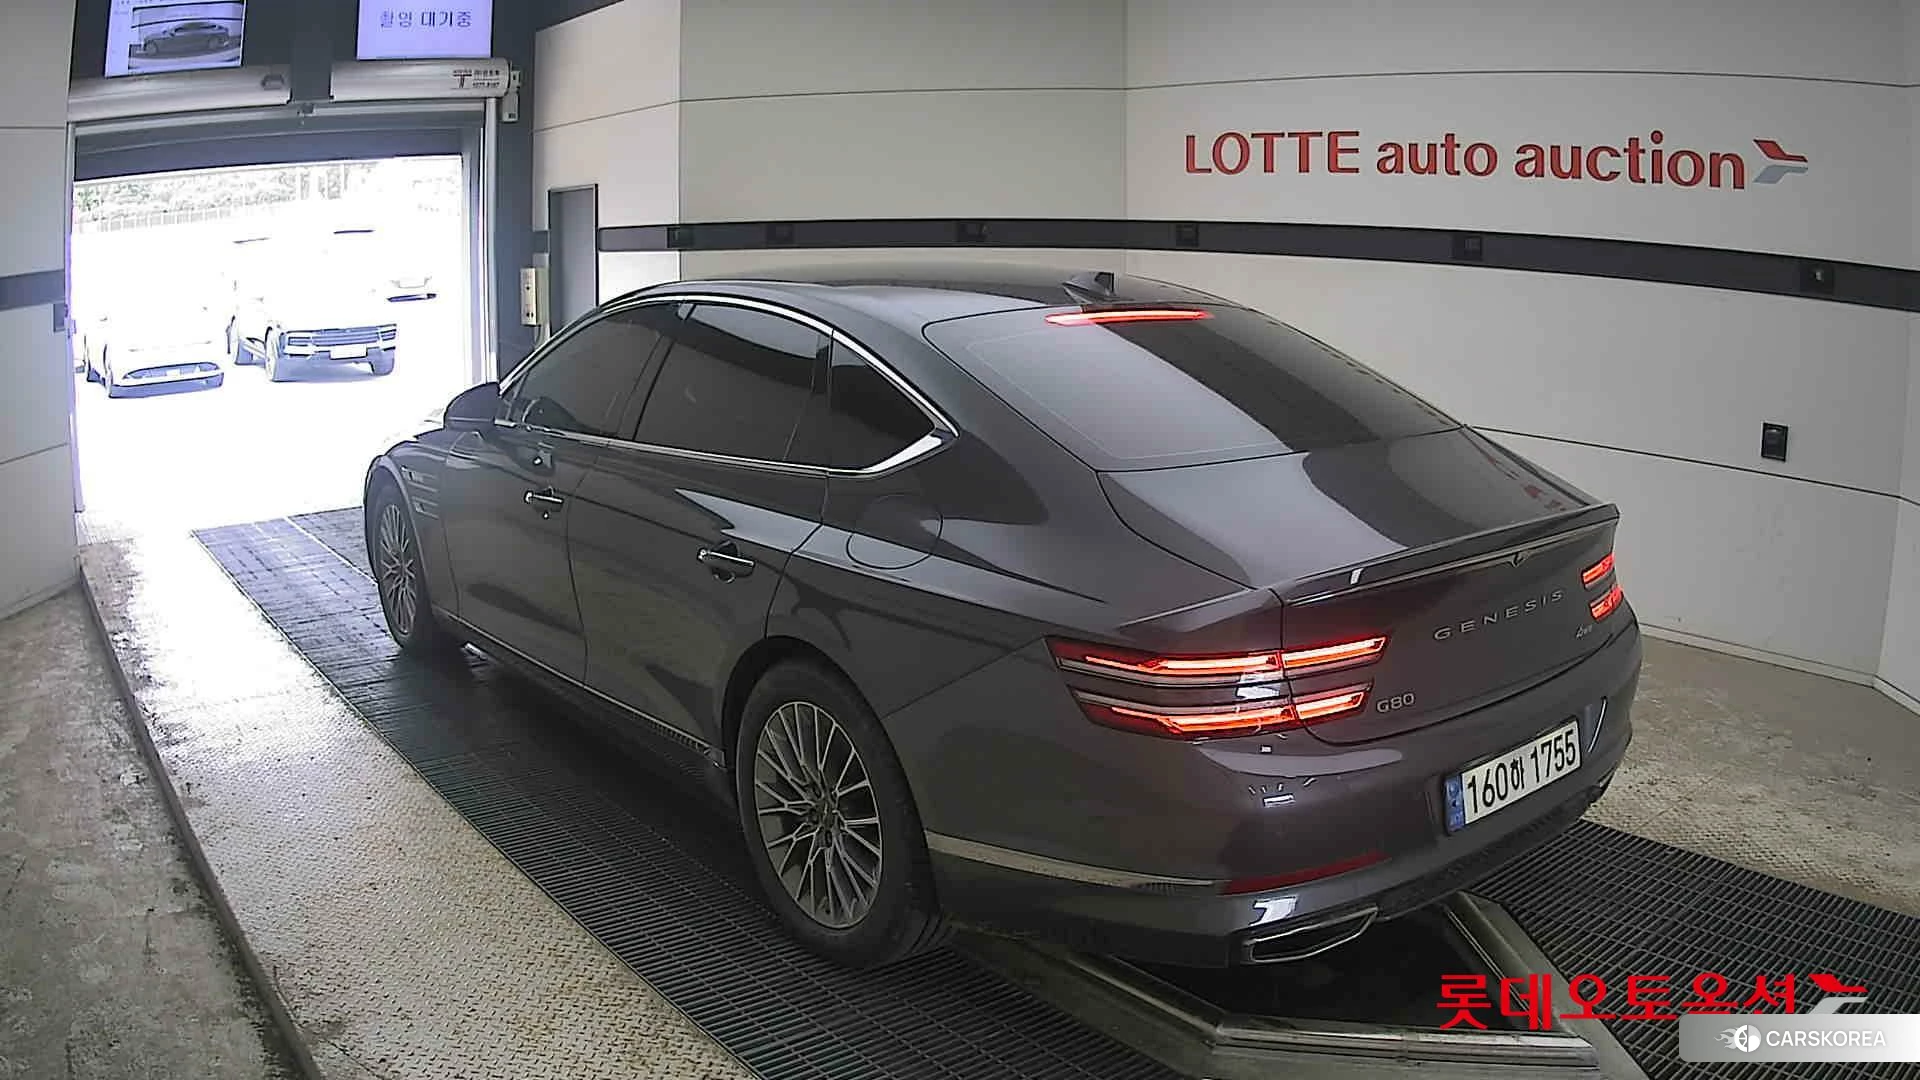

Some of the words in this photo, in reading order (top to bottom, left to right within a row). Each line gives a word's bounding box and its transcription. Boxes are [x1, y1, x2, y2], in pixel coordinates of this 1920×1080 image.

[420, 10, 472, 28] 대기중
[1185, 130, 1360, 175] LOTTE
[1376, 132, 1499, 177] auto
[1514, 130, 1746, 190] auction
[1433, 589, 1564, 641] GENESIS
[1376, 692, 1416, 714] G80
[1466, 756, 1525, 814] 160하
[1530, 729, 1577, 784] 1755
